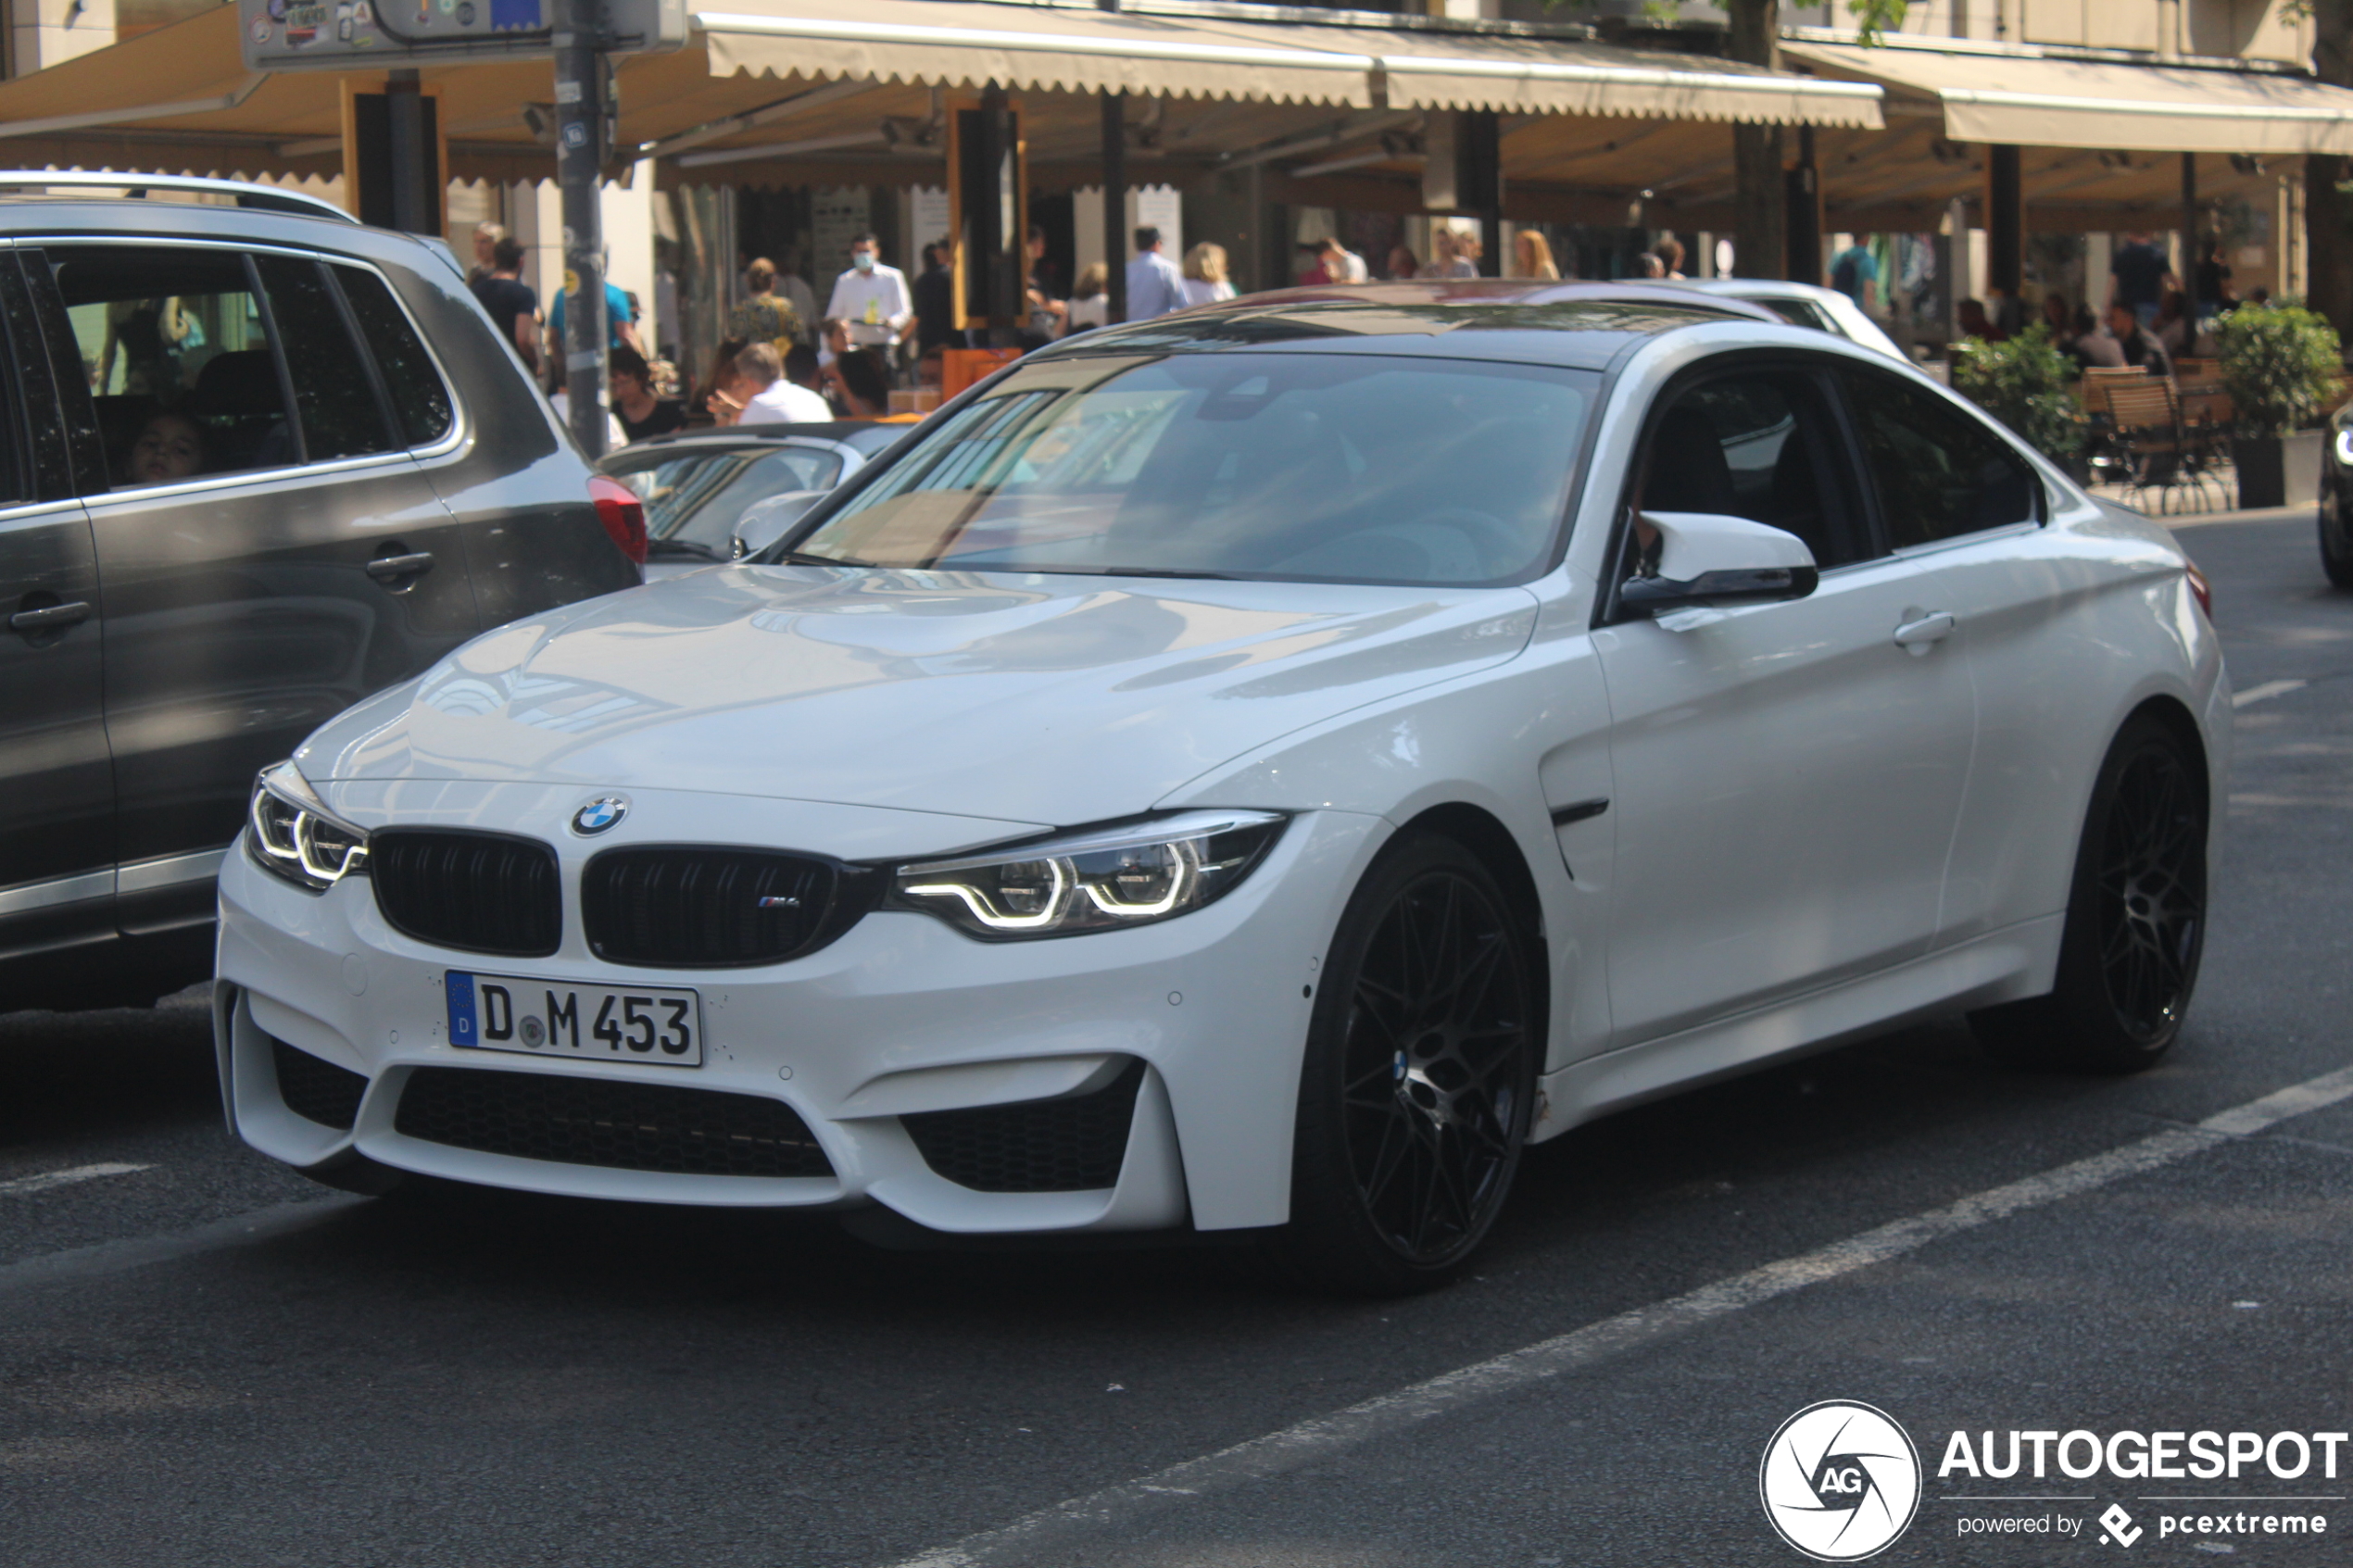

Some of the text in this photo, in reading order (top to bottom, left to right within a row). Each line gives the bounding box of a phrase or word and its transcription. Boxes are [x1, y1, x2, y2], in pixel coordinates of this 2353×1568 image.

[459, 1018, 470, 1034] D
[481, 984, 690, 1055] D M 453
